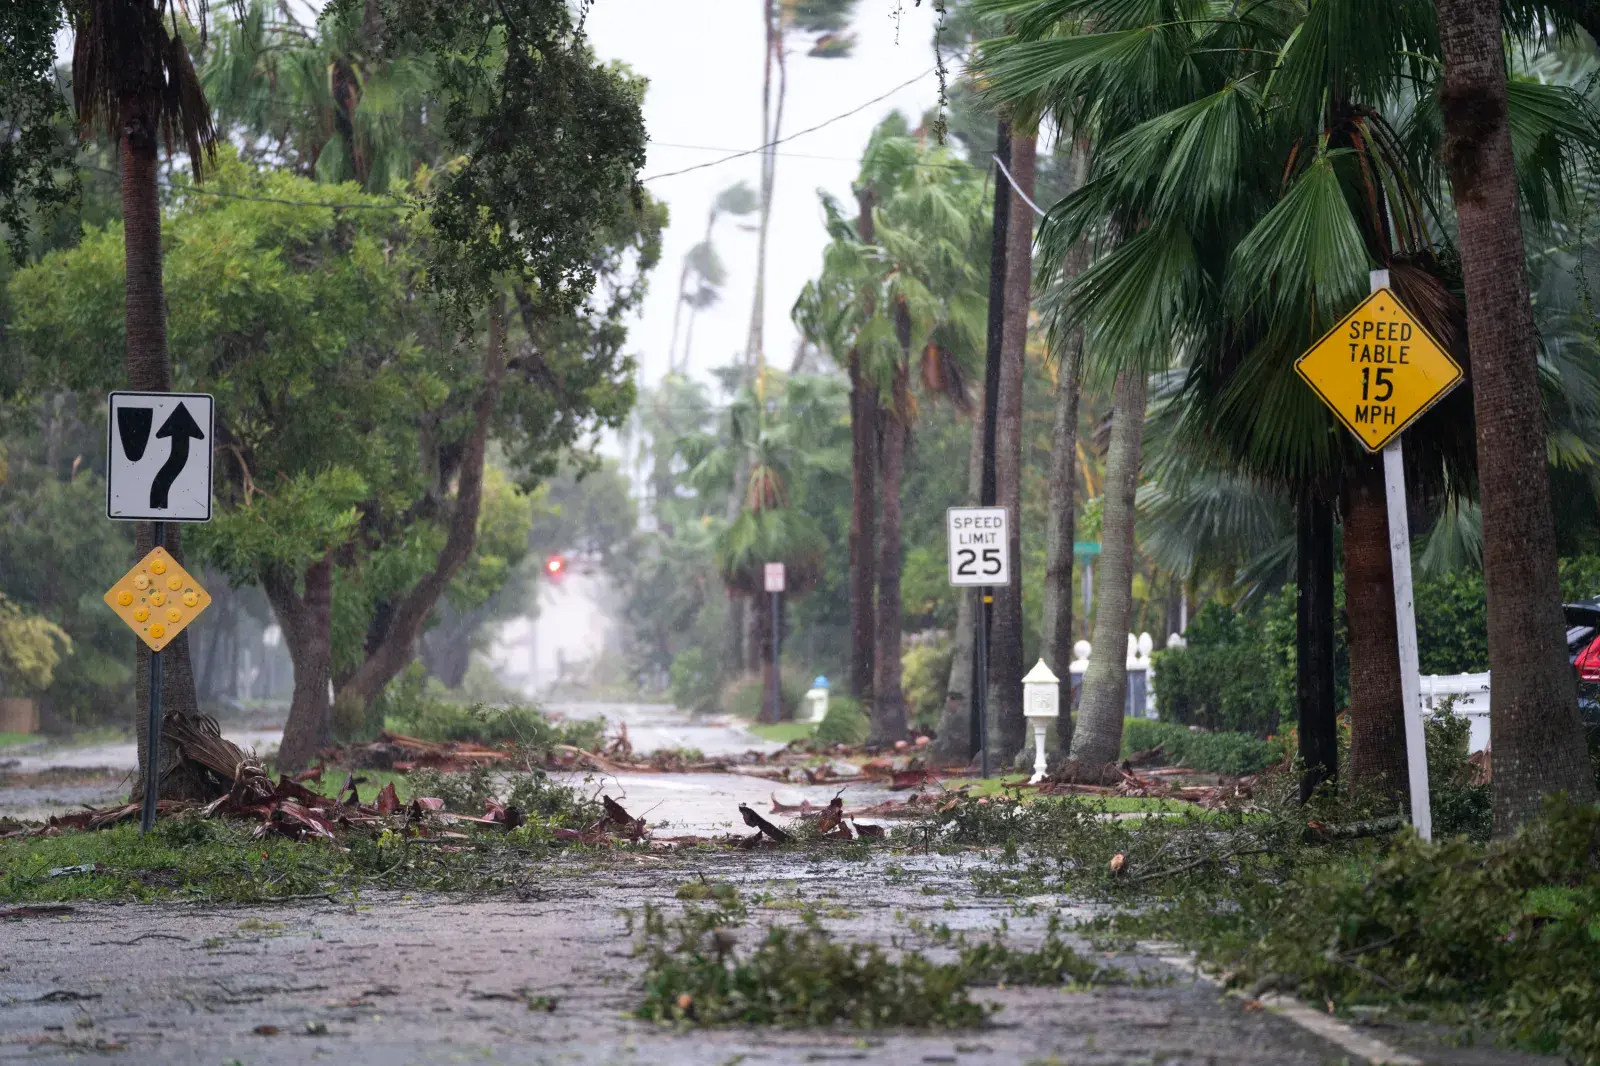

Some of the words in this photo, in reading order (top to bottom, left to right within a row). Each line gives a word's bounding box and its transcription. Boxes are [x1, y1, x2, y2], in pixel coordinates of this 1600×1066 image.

[1349, 321, 1412, 341] SPEED
[1349, 343, 1410, 364] TABLE
[1362, 367, 1394, 401] 15
[1355, 405, 1395, 425] MPH
[954, 517, 1002, 529] SPEED
[959, 533, 996, 545] LIMIT
[957, 548, 1001, 575] 25
